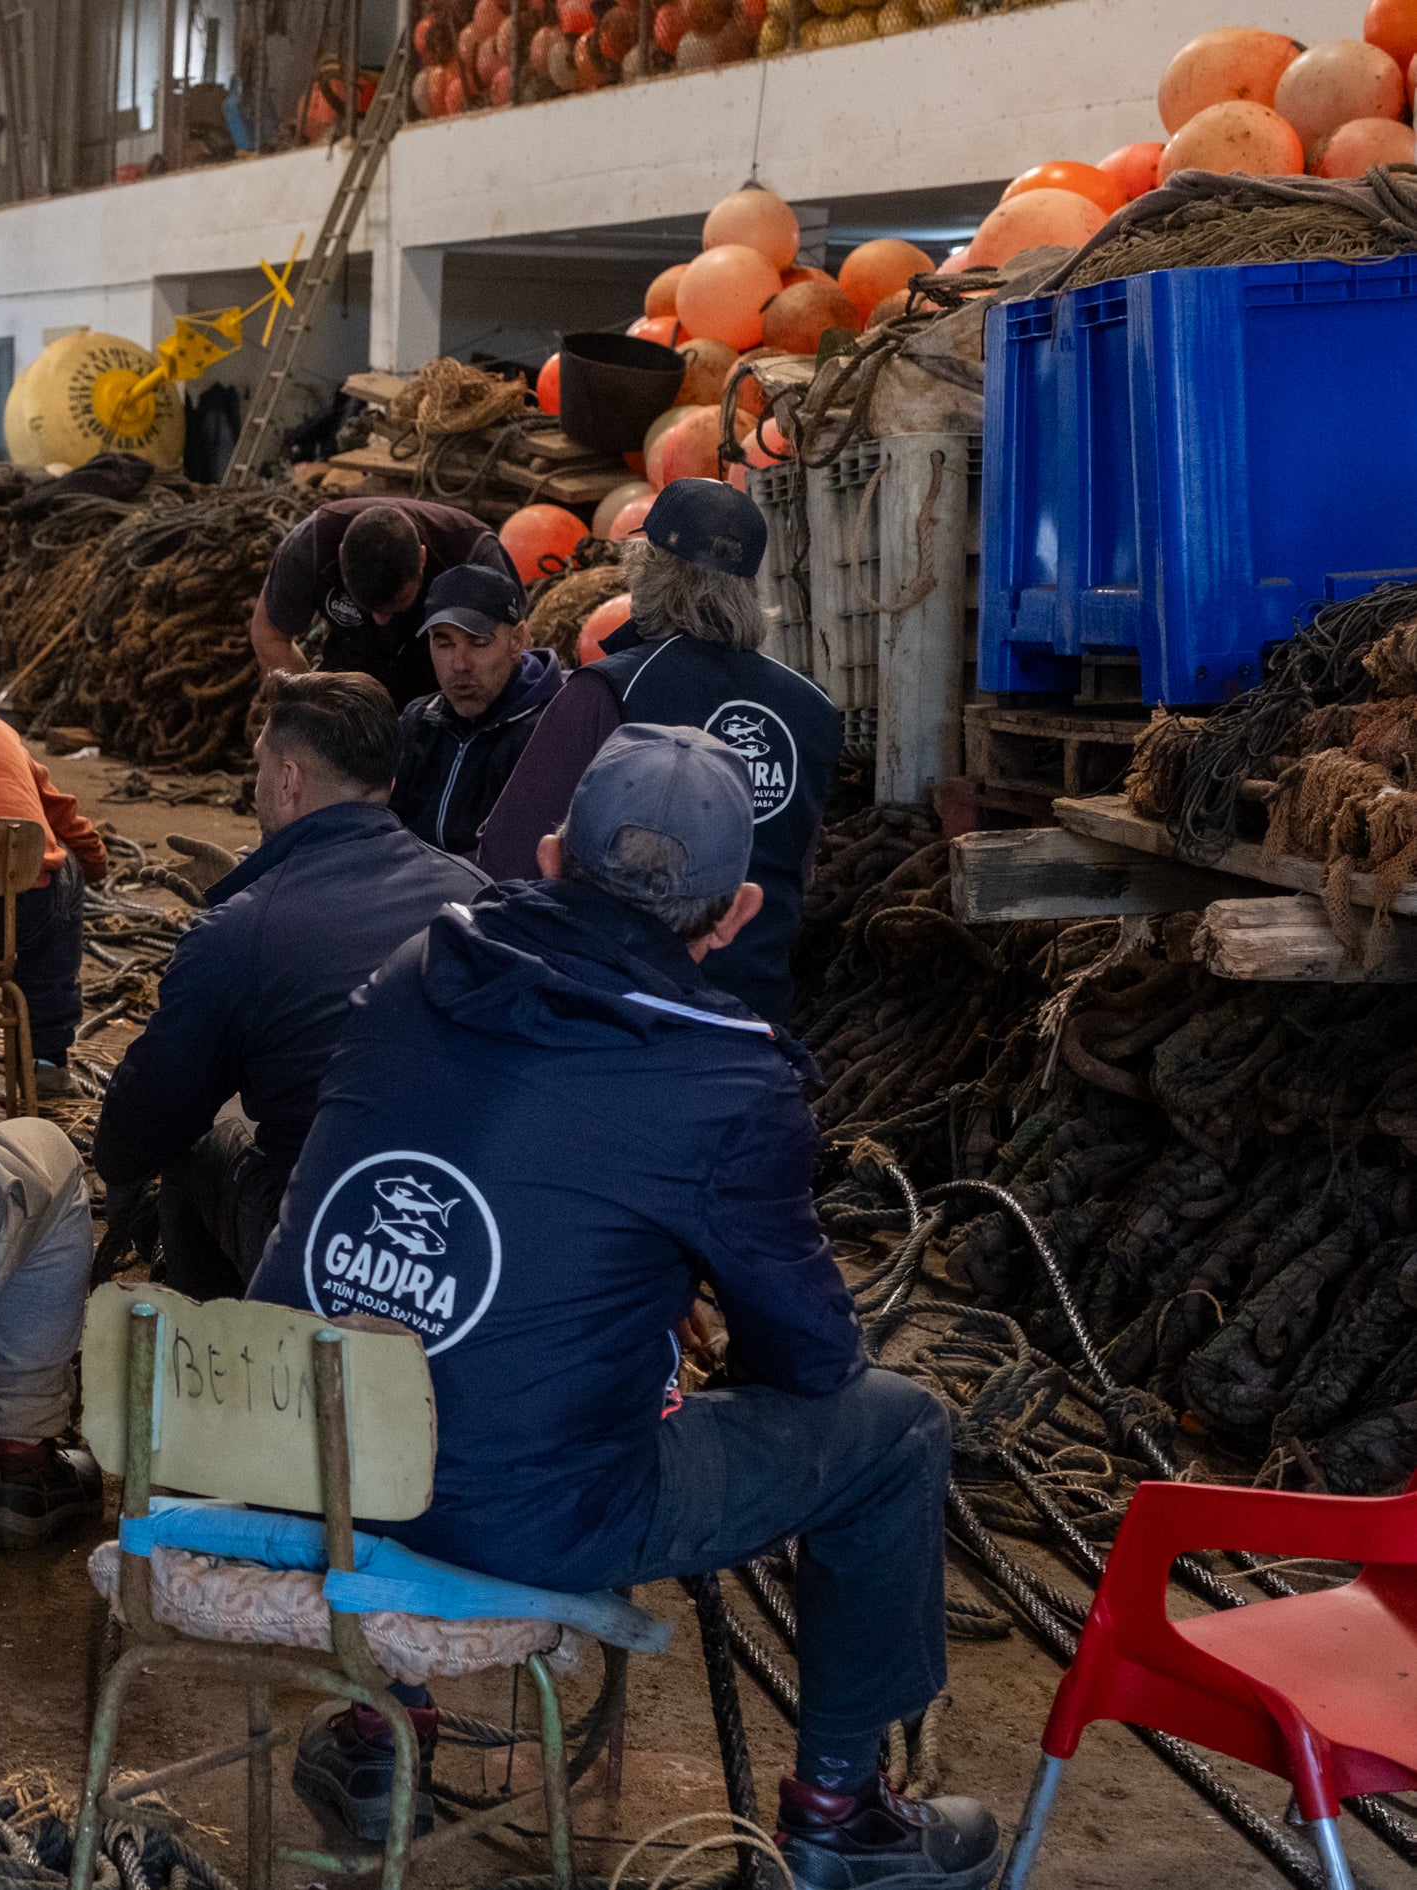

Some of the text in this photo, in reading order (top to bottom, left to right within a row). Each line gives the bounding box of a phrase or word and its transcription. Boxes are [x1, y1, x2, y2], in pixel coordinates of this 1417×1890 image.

[754, 789, 785, 798] ALVAJE
[325, 1233, 457, 1320] GADIRA
[323, 1279, 355, 1300] ATÚN
[356, 1291, 390, 1313] ROJO
